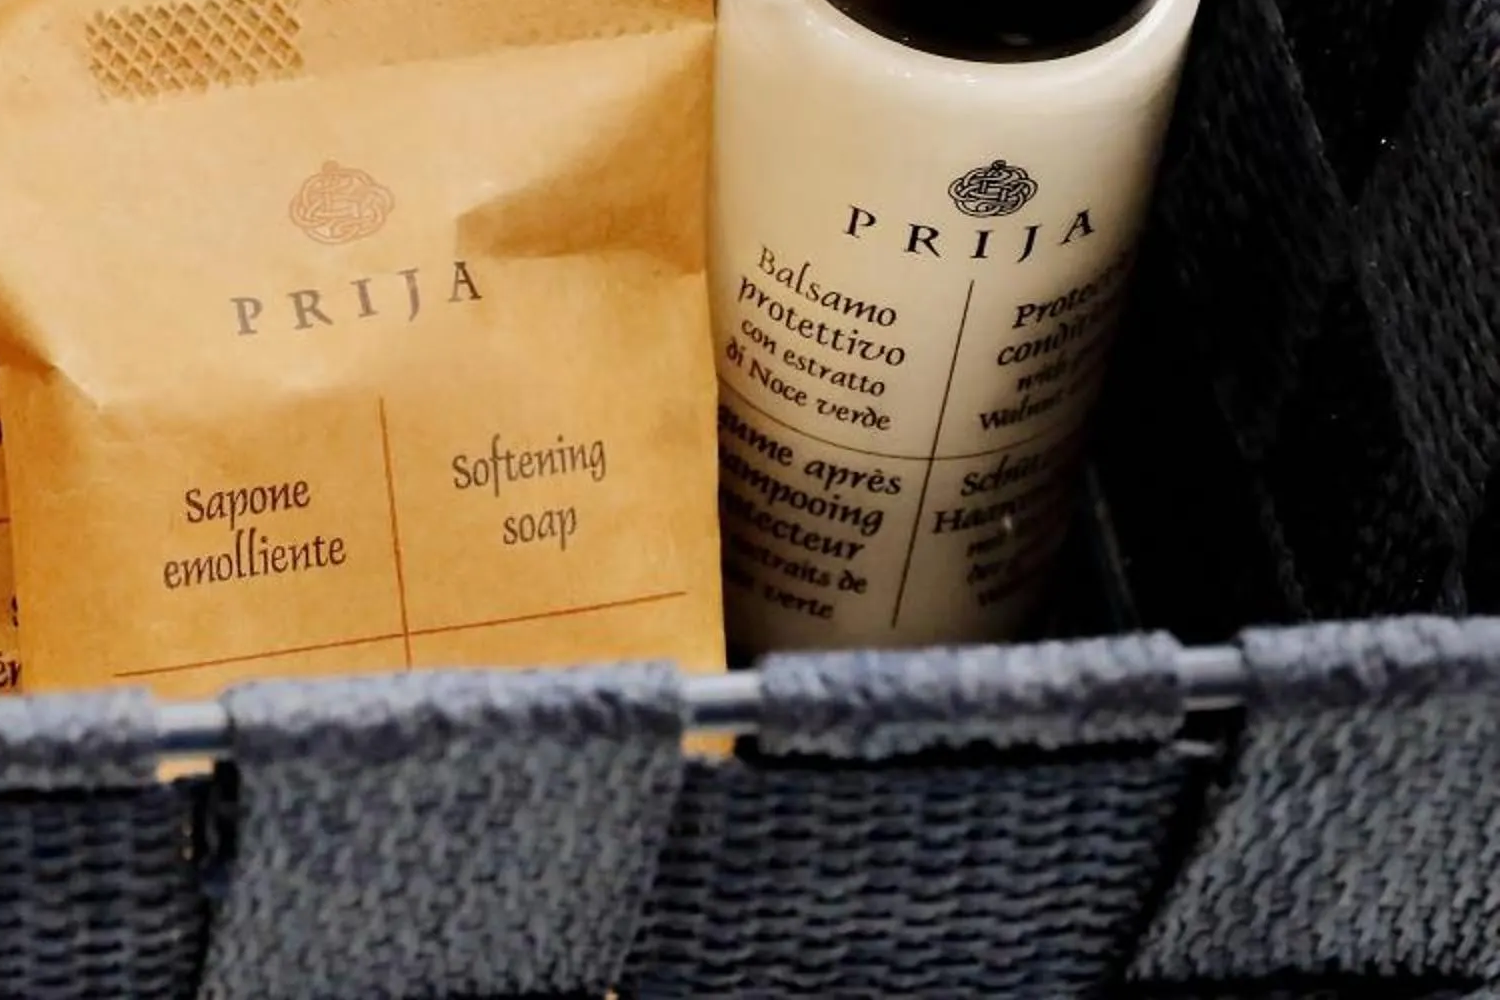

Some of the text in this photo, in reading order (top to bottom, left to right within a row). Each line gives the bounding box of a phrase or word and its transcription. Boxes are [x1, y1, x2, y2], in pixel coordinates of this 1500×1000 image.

[844, 203, 1097, 264] PRIJA
[230, 260, 483, 336] PRIJA
[757, 246, 898, 327] Balsamo
[737, 276, 907, 367] protettivo
[726, 336, 892, 431] di Noce verde
[741, 319, 886, 397] con estratto
[451, 432, 608, 497] Softening
[719, 404, 794, 467] aume
[184, 477, 311, 531] Sapone
[719, 447, 885, 537] ampooing
[162, 527, 348, 589] emolliente
[501, 504, 578, 552] soap
[837, 568, 868, 595] de
